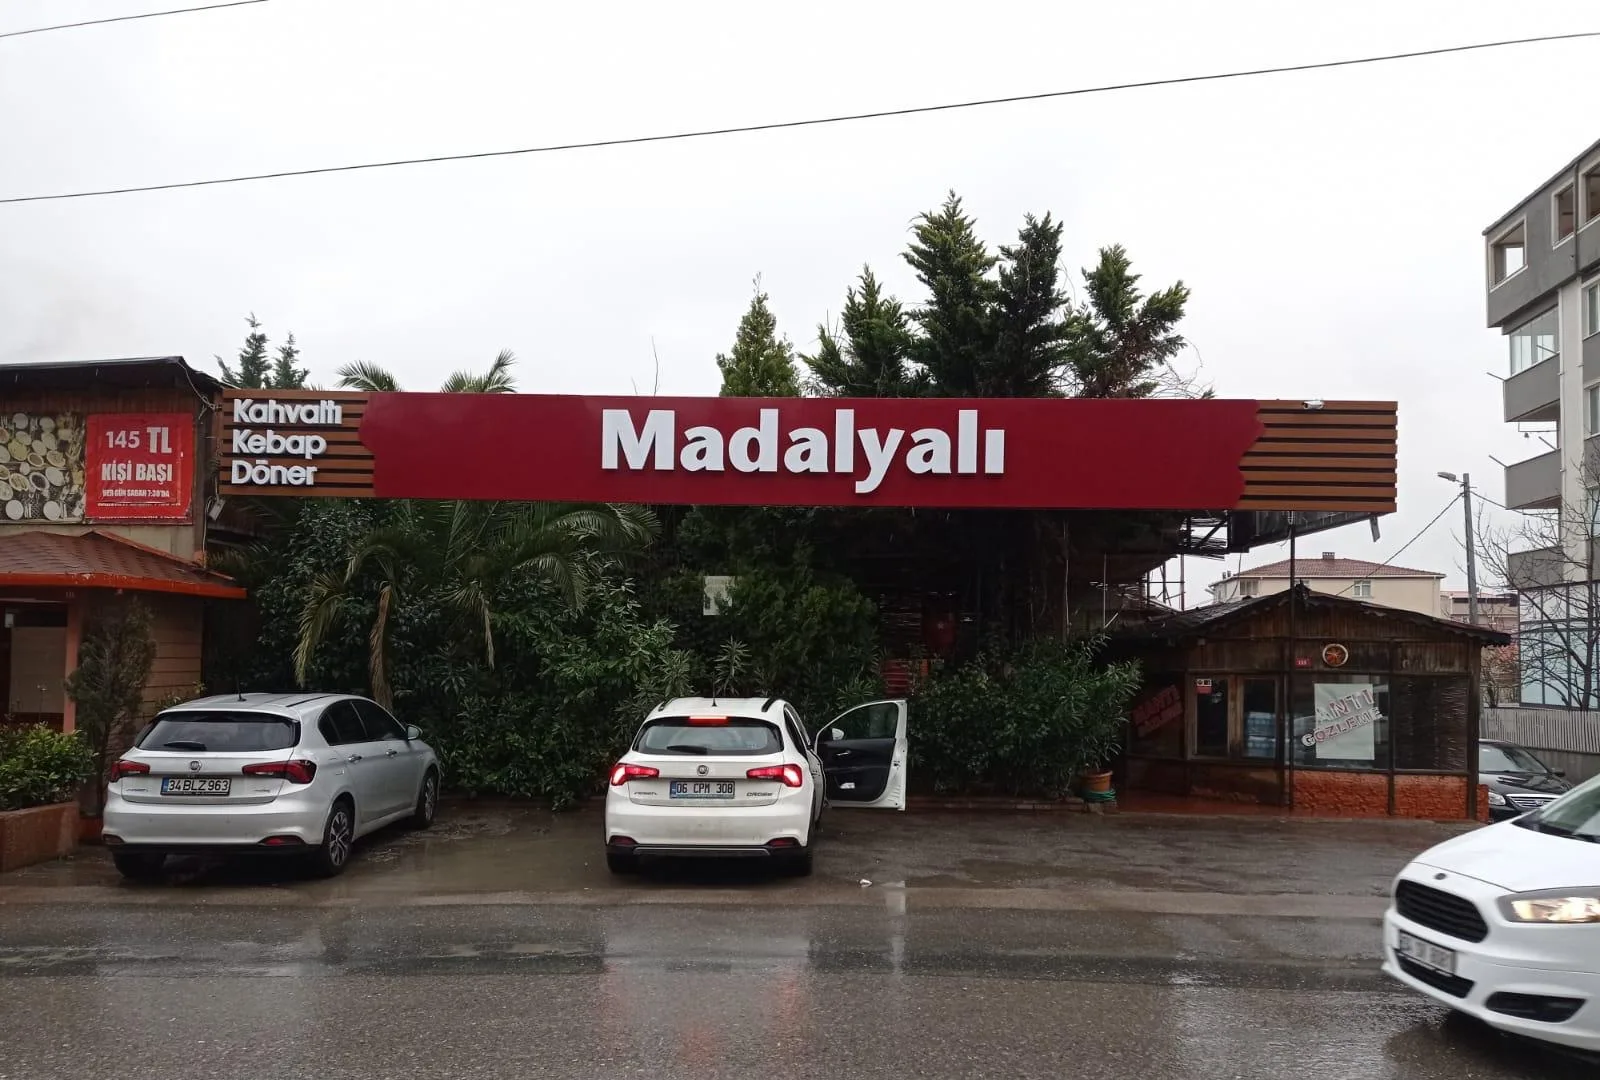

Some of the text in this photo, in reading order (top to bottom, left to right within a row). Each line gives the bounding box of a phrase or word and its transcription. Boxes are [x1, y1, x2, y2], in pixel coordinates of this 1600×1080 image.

[233, 398, 342, 424] Kahvaltı
[105, 426, 172, 454] 145 TL
[232, 429, 327, 460] Kebap
[601, 408, 1005, 493] Madalyalı
[101, 460, 173, 485] KİŞİ BAŞI
[168, 779, 229, 791] 34 BLZ 963
[676, 783, 733, 794] 06 CPM 308
